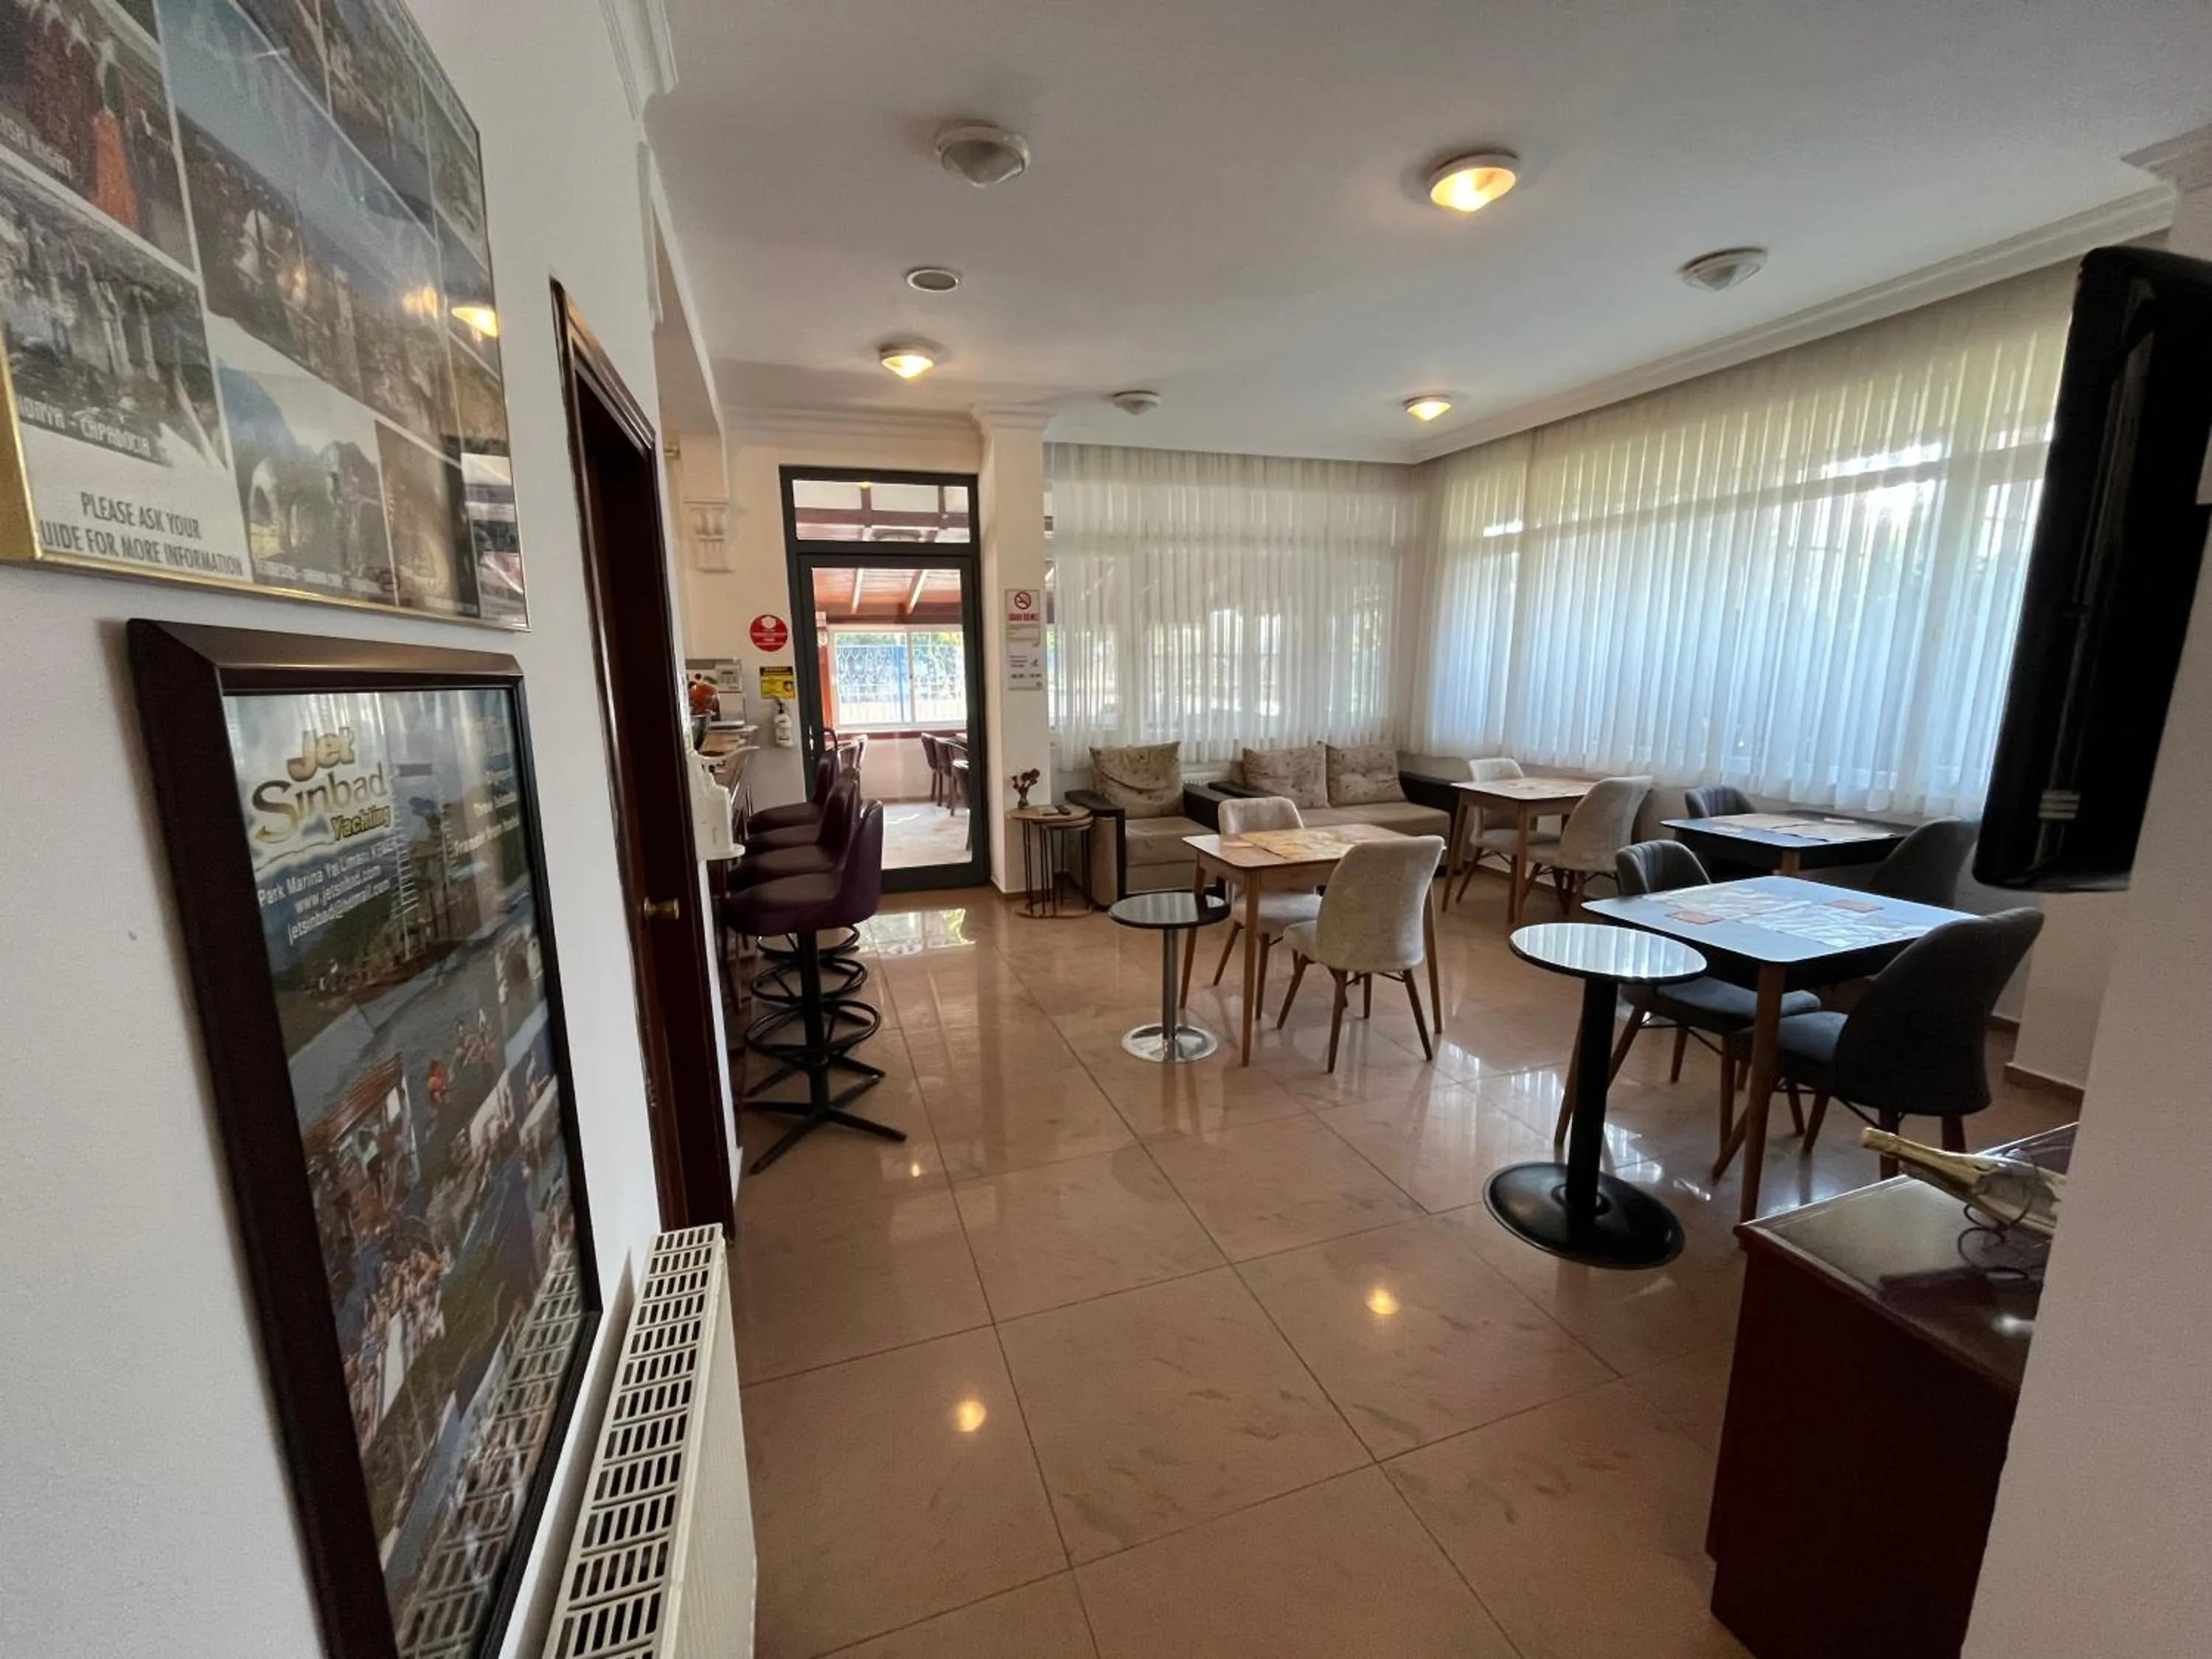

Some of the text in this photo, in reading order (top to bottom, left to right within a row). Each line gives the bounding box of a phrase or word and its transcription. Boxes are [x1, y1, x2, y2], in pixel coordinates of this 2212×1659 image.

[80, 491, 202, 540] PLEASE ASK YOUR
[40, 520, 83, 551] UIDE
[85, 528, 119, 557] FOR
[120, 536, 162, 564] MORE
[164, 543, 244, 576] INFORMATION
[287, 727, 355, 782] Jet
[330, 804, 390, 841] Yachting
[258, 883, 286, 907] Park
